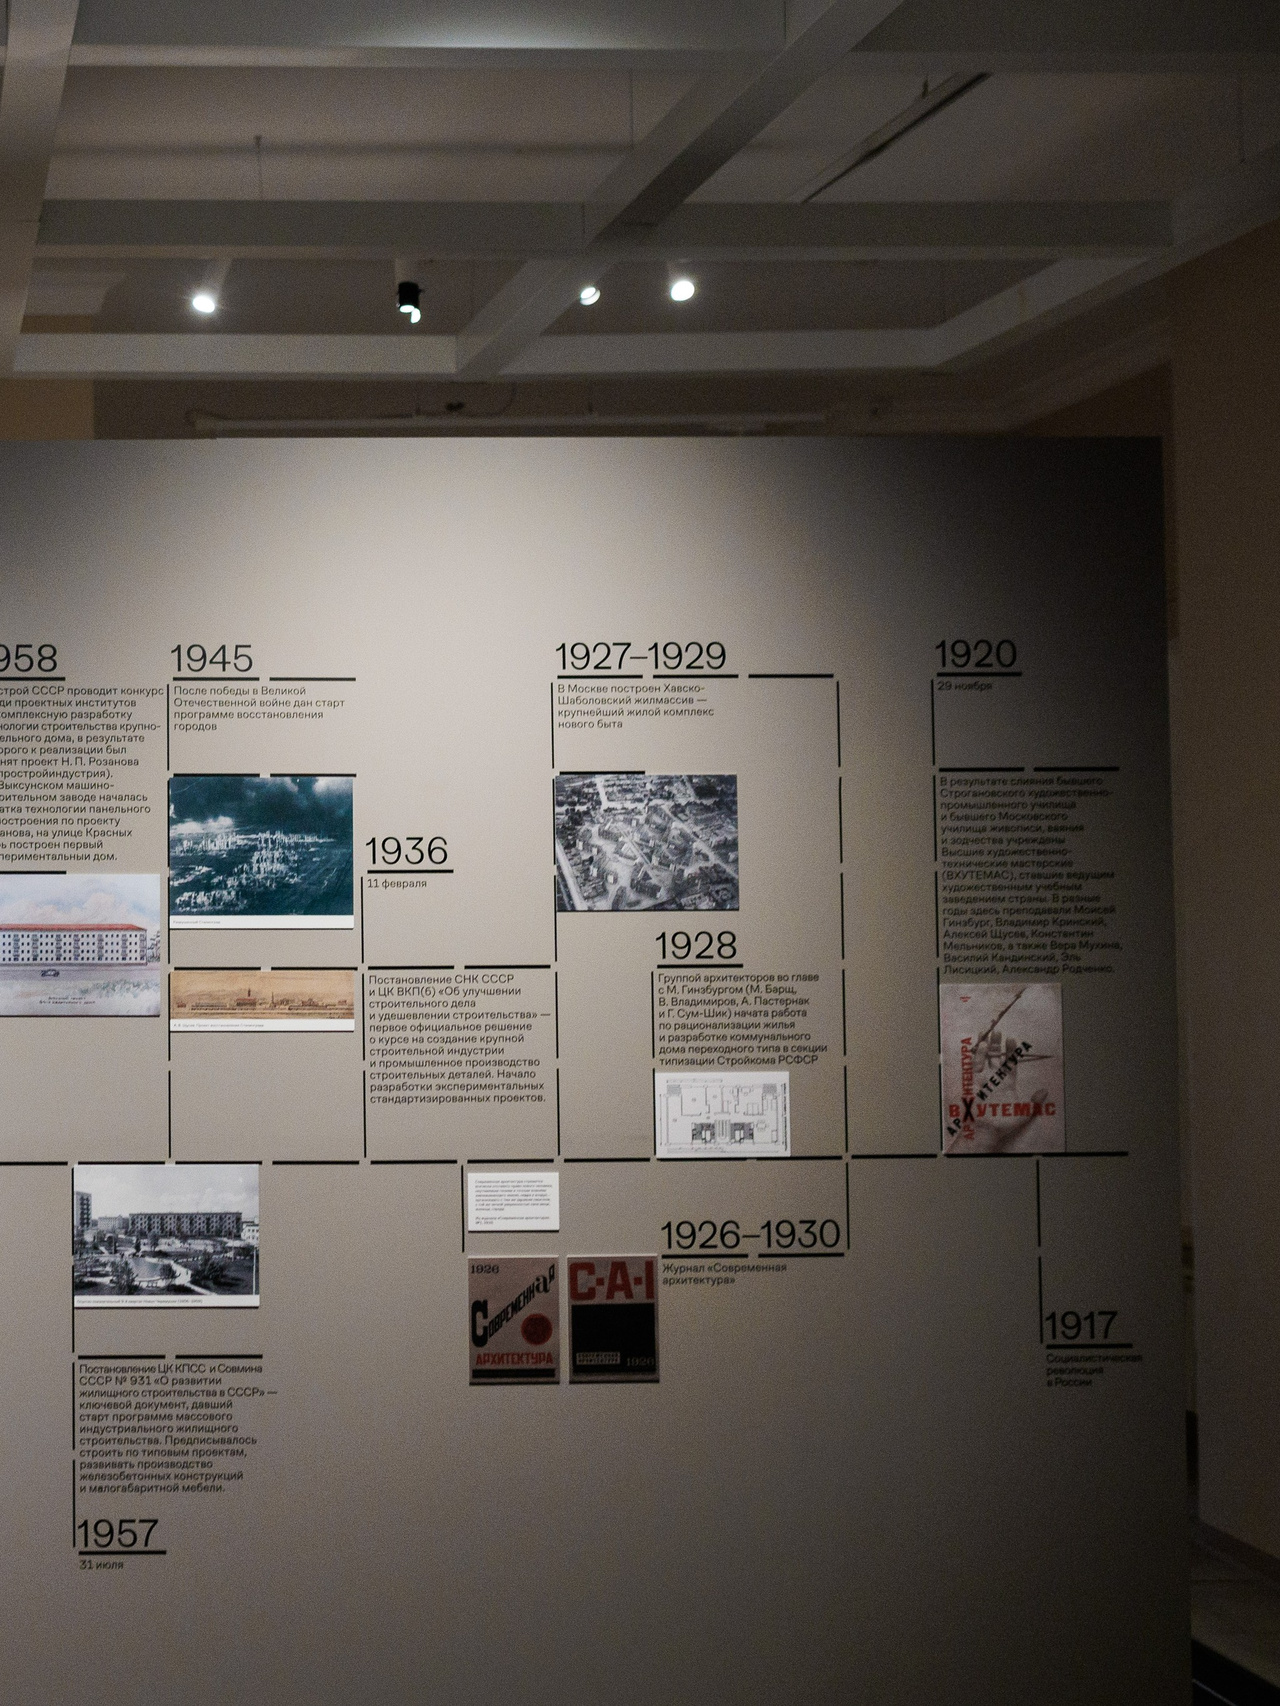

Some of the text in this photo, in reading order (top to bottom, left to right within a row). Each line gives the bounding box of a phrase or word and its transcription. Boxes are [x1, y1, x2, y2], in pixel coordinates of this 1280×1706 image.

[170, 643, 253, 673] 1945
[555, 641, 727, 671] 1927–1929
[935, 638, 1017, 668] 1920
[31, 685, 65, 696] СССР
[66, 687, 118, 698] проводит
[120, 687, 164, 698] конкурс
[173, 685, 306, 697] После победы в Великой
[557, 682, 705, 695] В Москве построен Хавско-
[14, 699, 73, 709] проектных
[74, 699, 136, 709] институтов
[173, 697, 344, 709] Отечественной войне дан старт
[557, 695, 694, 705] Шаболовский жилмассив
[70, 709, 133, 721] разработку
[173, 711, 323, 721] программе восстановления
[557, 706, 714, 719] крупнейший жилой комплекс
[40, 723, 117, 733] строительства
[119, 723, 161, 733] крупно-
[173, 722, 217, 733] городов
[557, 718, 623, 729] нового быта
[365, 836, 448, 865] 1936
[367, 878, 427, 890] 11 февраля
[655, 930, 737, 960] 1928
[368, 974, 514, 985] Постановление СНК СССР
[368, 1000, 476, 1010] строительного дела
[368, 1021, 532, 1034] первое официальное решение
[658, 1021, 795, 1032] по рационализации жилья
[658, 1031, 811, 1044] и разработке коммунального
[661, 1218, 841, 1250] 1926–1930
[662, 1262, 787, 1275] Журнал «Современная
[661, 1277, 736, 1287] архитектура»
[1045, 1310, 1118, 1341] 1917
[476, 1352, 554, 1366] АРХИТЕКТУРА
[78, 1413, 233, 1423] старт программе массового
[79, 1425, 239, 1435] индустриального жилищного
[77, 1518, 159, 1549] 1957
[79, 1559, 124, 1569] 31 июля
